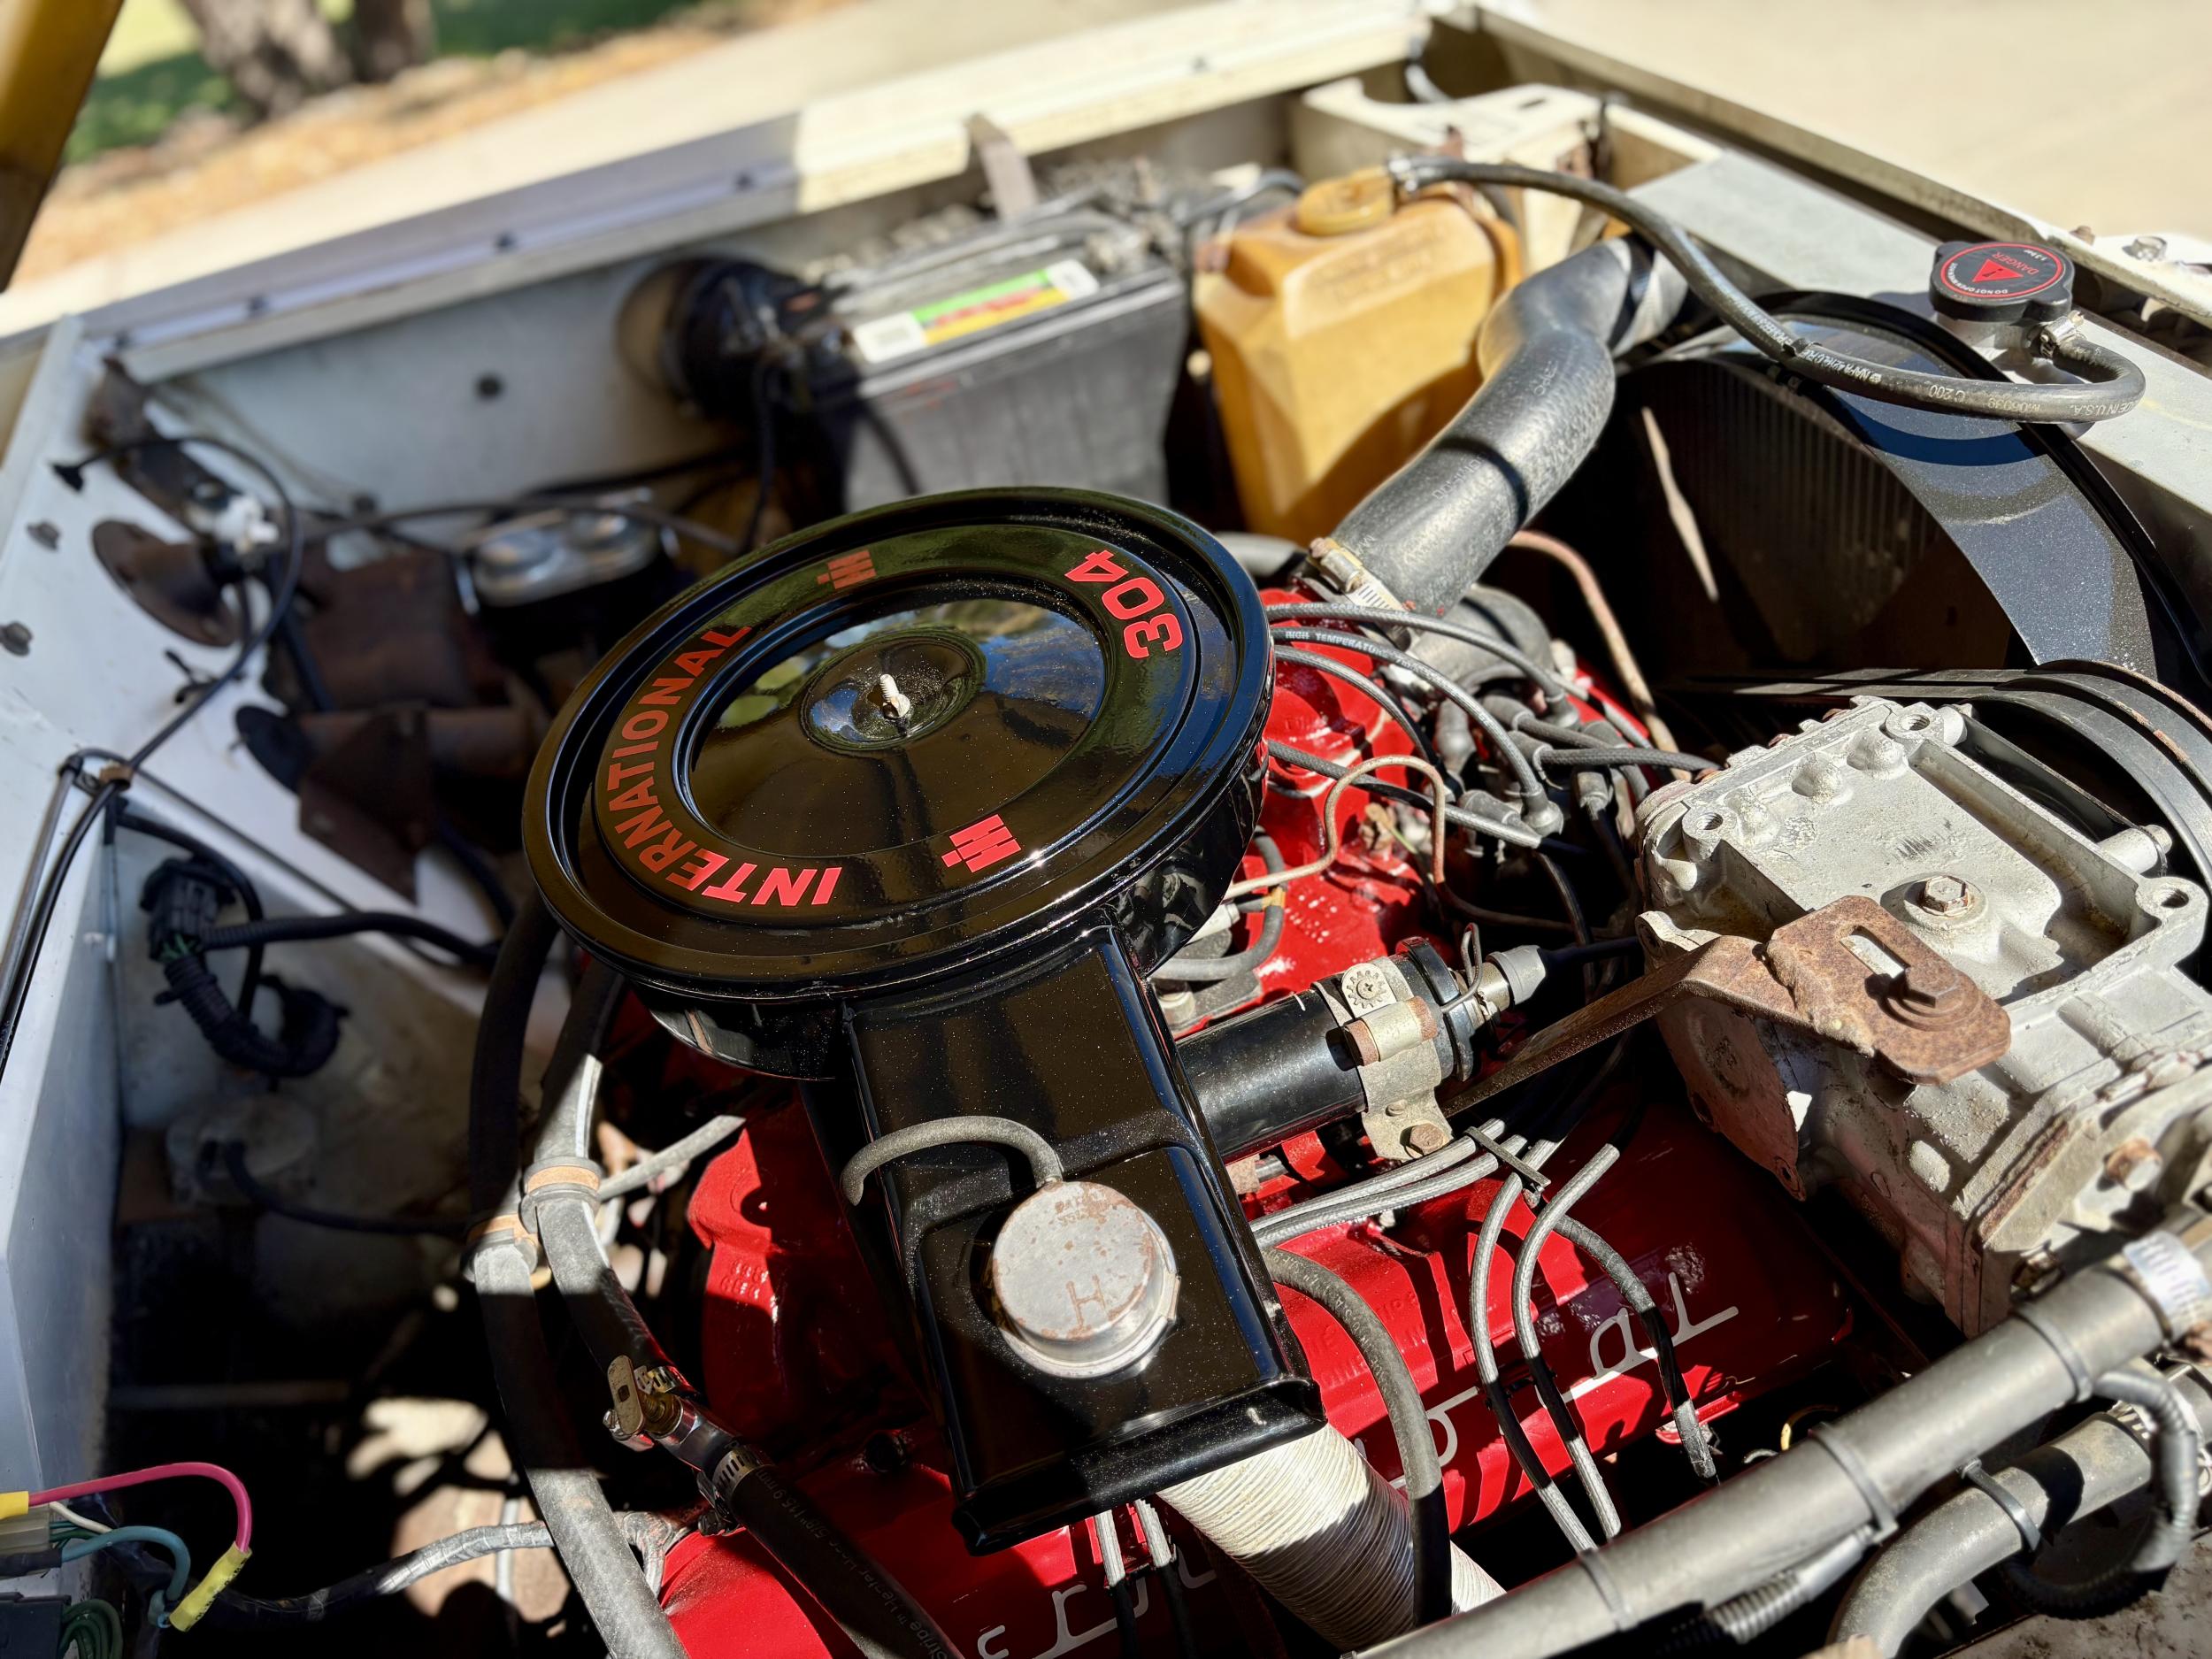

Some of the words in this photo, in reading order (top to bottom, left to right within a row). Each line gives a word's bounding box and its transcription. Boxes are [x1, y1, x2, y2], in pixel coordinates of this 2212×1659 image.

[1992, 250, 2039, 275] DANGER
[1929, 384, 1954, 399] 200
[2069, 404, 2106, 416] U.S.A.
[1064, 549, 1184, 661] 304
[1285, 631, 1311, 641] HIGH
[607, 626, 843, 909] INTERNATIONAL
